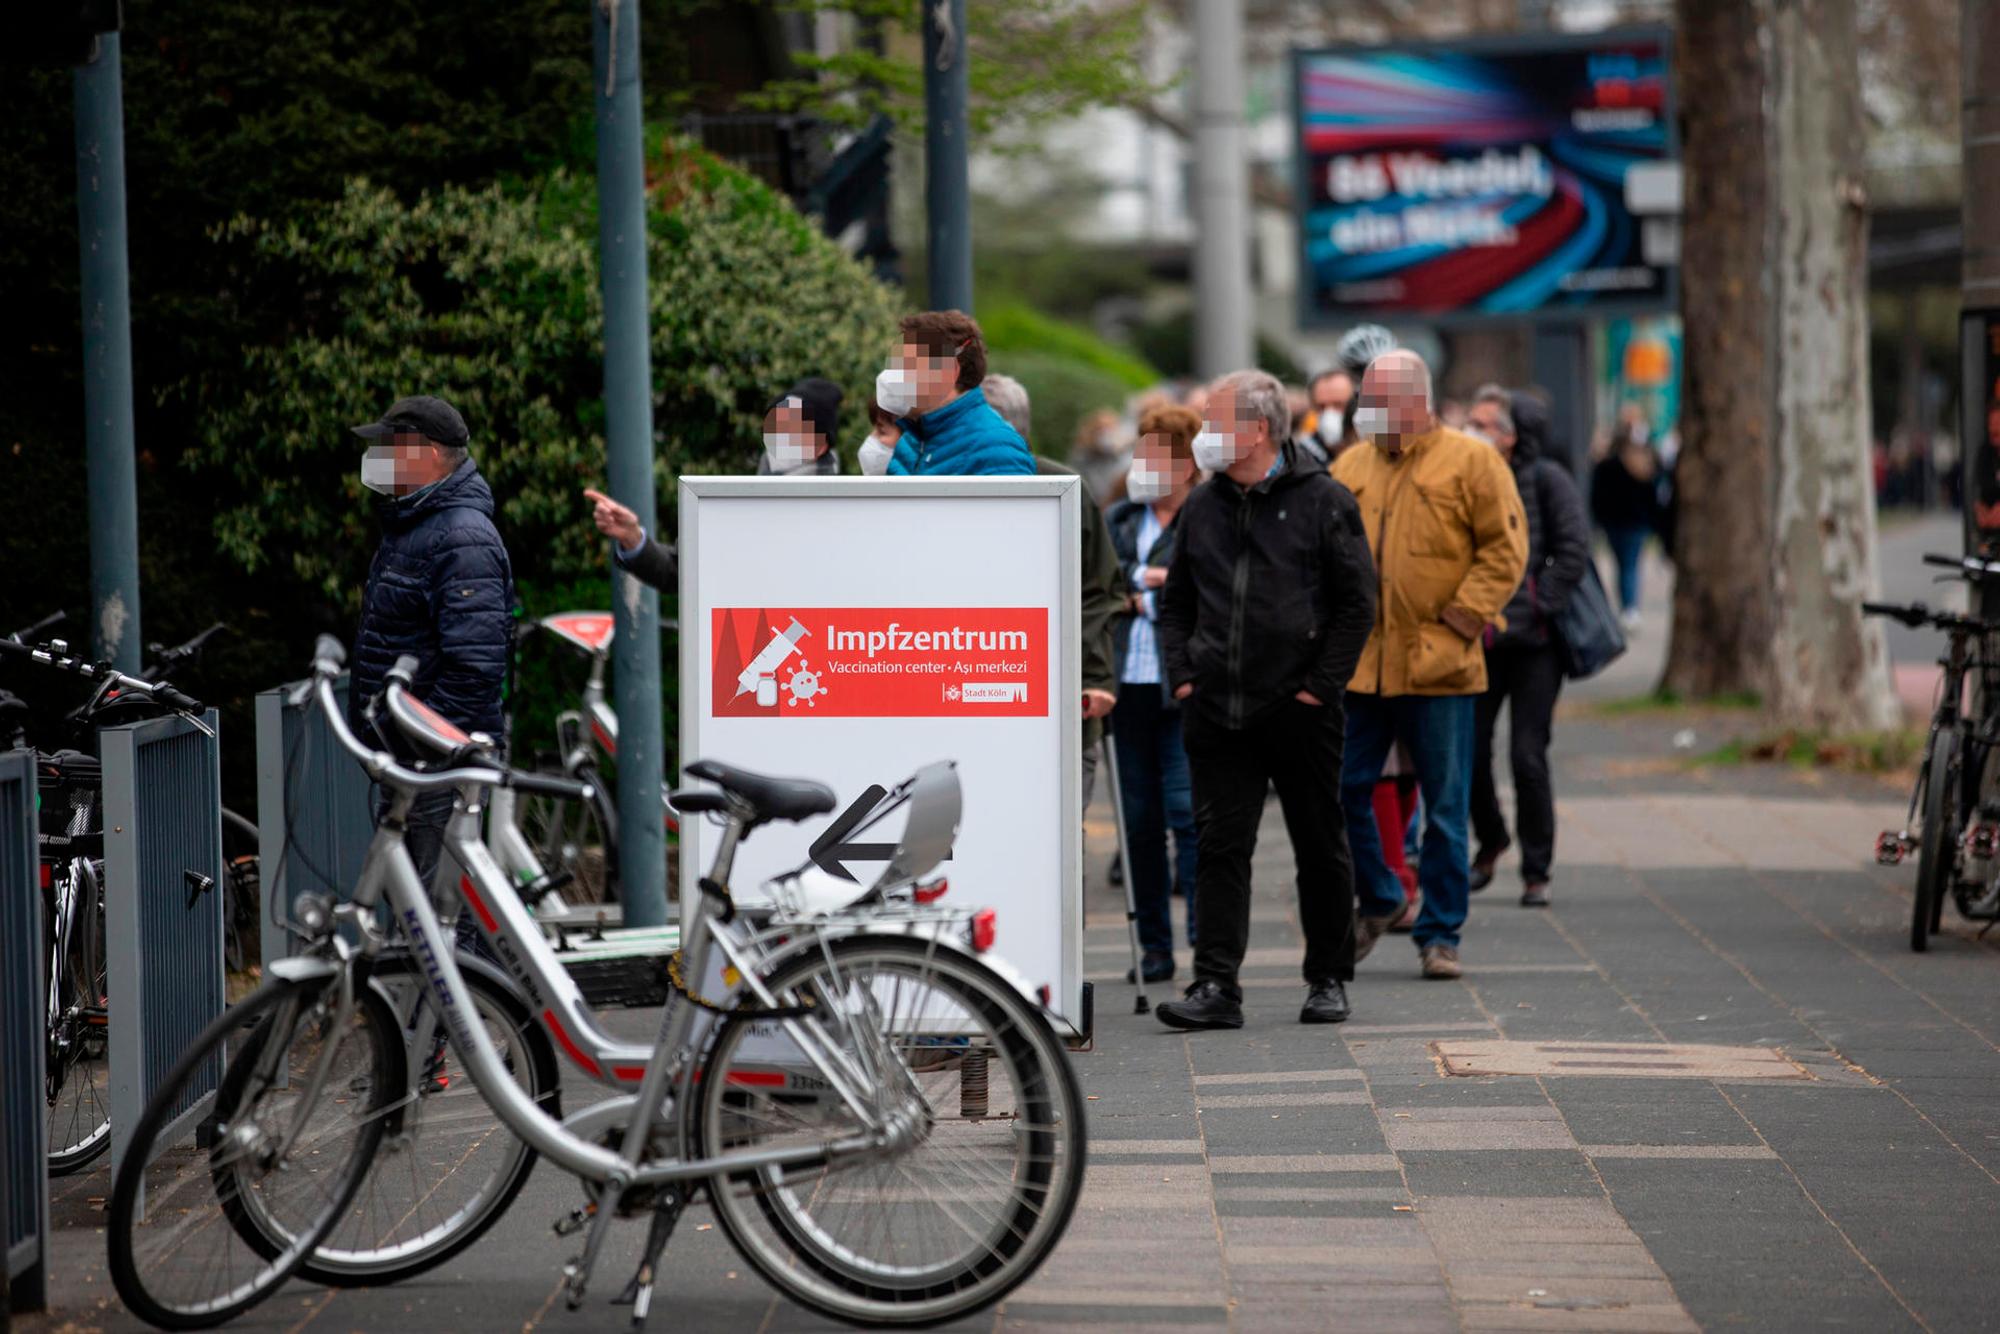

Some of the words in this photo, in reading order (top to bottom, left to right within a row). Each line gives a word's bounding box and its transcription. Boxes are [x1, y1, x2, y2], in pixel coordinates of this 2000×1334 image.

[827, 623, 1028, 658] Impfzentrum
[828, 660, 902, 674] Vaccination
[953, 661, 973, 675] Aşı
[976, 660, 1027, 674] merkezi
[964, 688, 986, 698] Stadt
[988, 688, 1007, 698] Köln
[404, 907, 455, 1008] KETTLER
